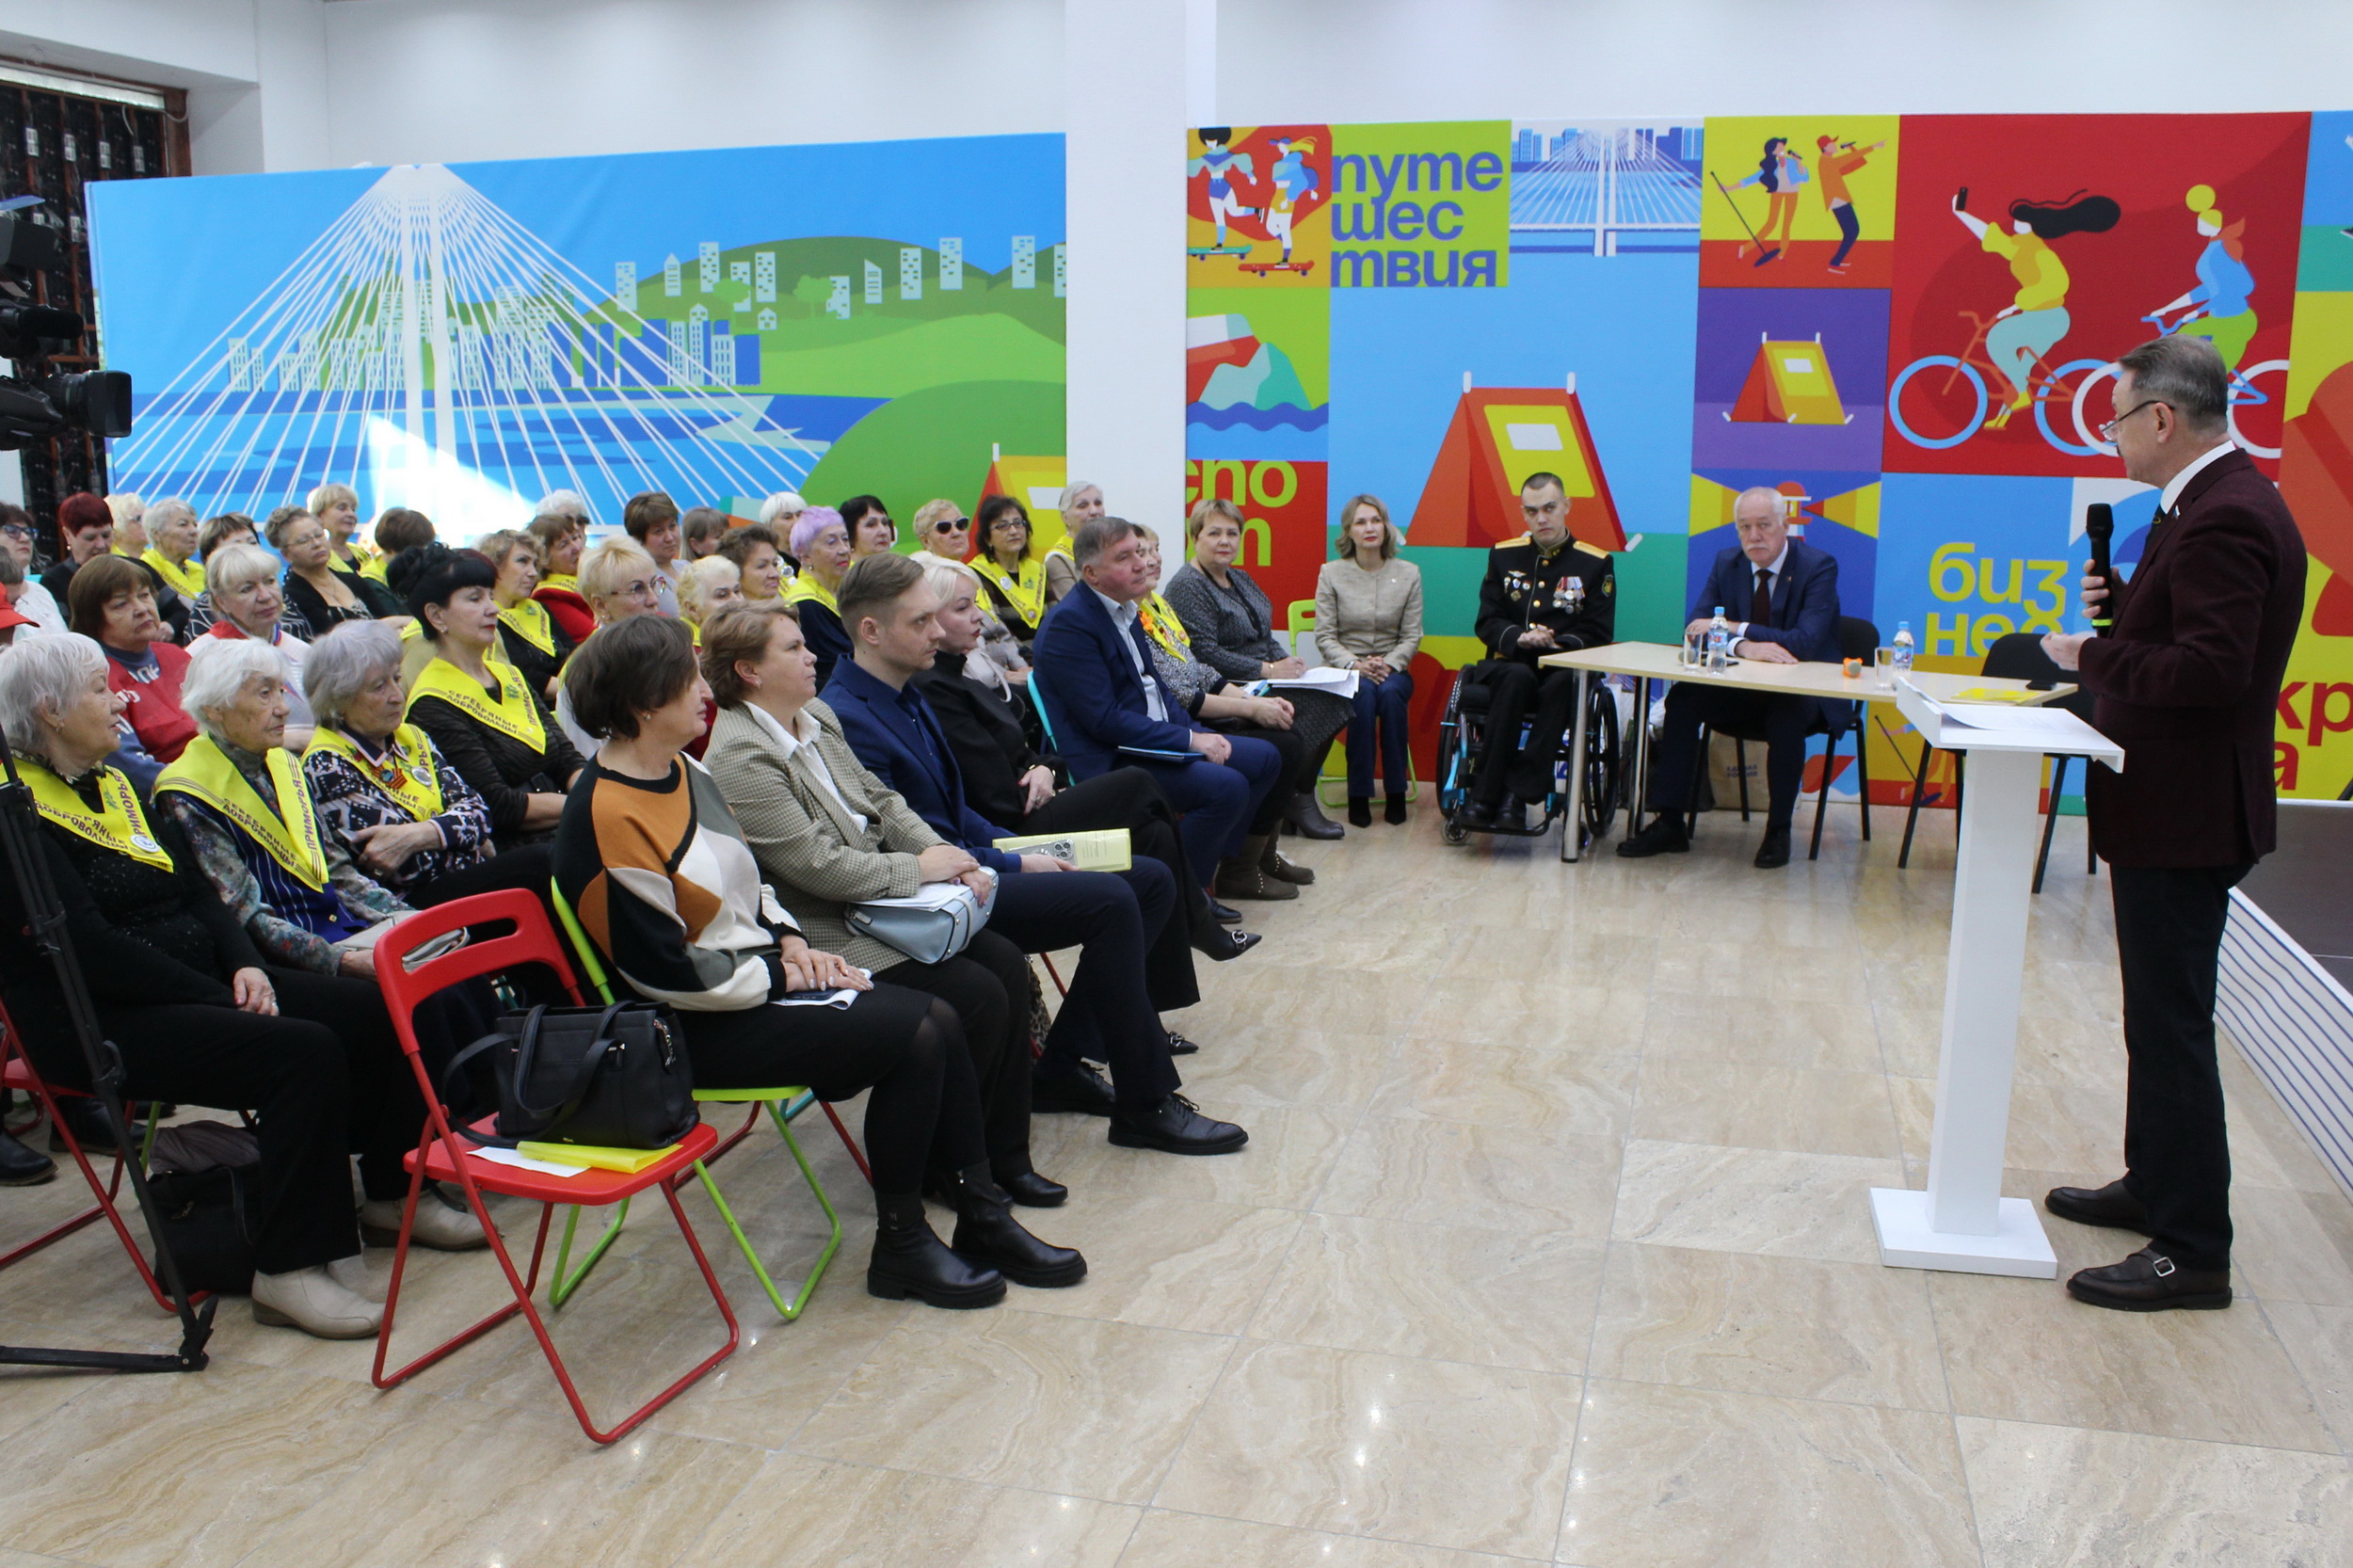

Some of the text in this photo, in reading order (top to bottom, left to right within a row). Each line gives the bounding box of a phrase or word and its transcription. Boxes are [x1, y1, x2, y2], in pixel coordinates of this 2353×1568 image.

[1331, 151, 1504, 205] путе
[1331, 199, 1465, 242] шес
[1330, 248, 1497, 287] твия
[1929, 542, 2069, 616] биз
[113, 774, 148, 840] РИМОРЬЯ
[292, 778, 317, 850] ПРИМОРЬЯ
